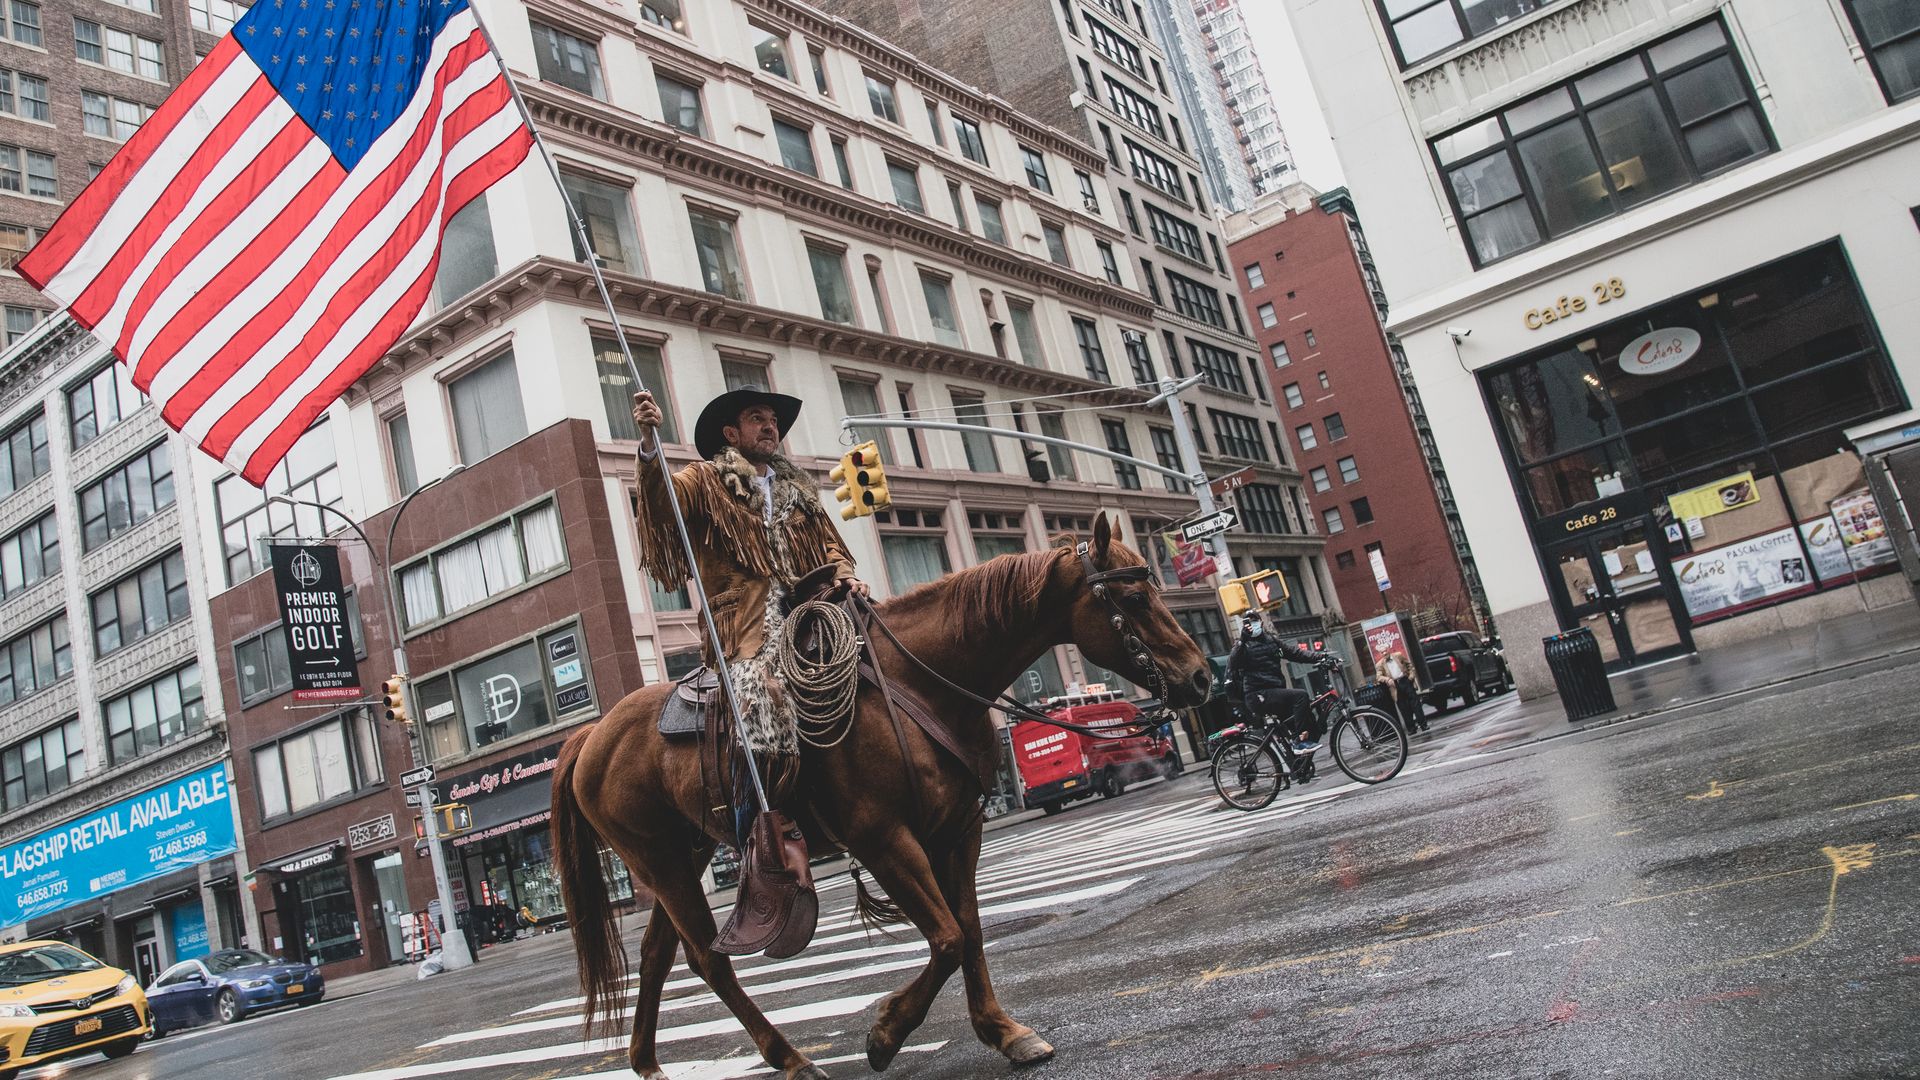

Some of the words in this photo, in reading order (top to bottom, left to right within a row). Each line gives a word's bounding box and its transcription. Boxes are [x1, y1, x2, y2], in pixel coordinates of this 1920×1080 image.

[1523, 295, 1587, 330] Cafe
[1592, 277, 1626, 305] 28
[1224, 480, 1229, 490] 5
[1232, 476, 1242, 487] Av
[1190, 524, 1206, 535] ONE
[1213, 515, 1229, 527] WAY
[1565, 514, 1597, 531] Cafe
[1600, 507, 1616, 520] 28
[1669, 527, 1679, 538] A
[1726, 542, 1759, 559] PASCAL
[1760, 533, 1794, 552] COFFEE
[286, 592, 337, 606] PREMIER
[288, 608, 341, 624] INDOOR
[291, 625, 342, 651] GOLF
[558, 664, 577, 676] SPA
[298, 689, 360, 698] PREMIERINDOORGOLF.COM
[1048, 732, 1068, 743] GLASS
[405, 775, 415, 785] ONE
[419, 771, 430, 780] WAY
[450, 782, 480, 800] Smoke
[501, 768, 511, 784] &
[70, 811, 127, 853] RETAIL
[130, 771, 227, 832] AVAILABLE
[156, 825, 176, 840] Steven
[351, 828, 371, 844] 253
[149, 830, 207, 863] 212.468.5968
[281, 863, 294, 872] BAR
[294, 861, 301, 871] &
[301, 851, 333, 868] KITCHEN
[17, 879, 69, 908] 646.658.7373
[178, 930, 208, 947] 212.468.59
